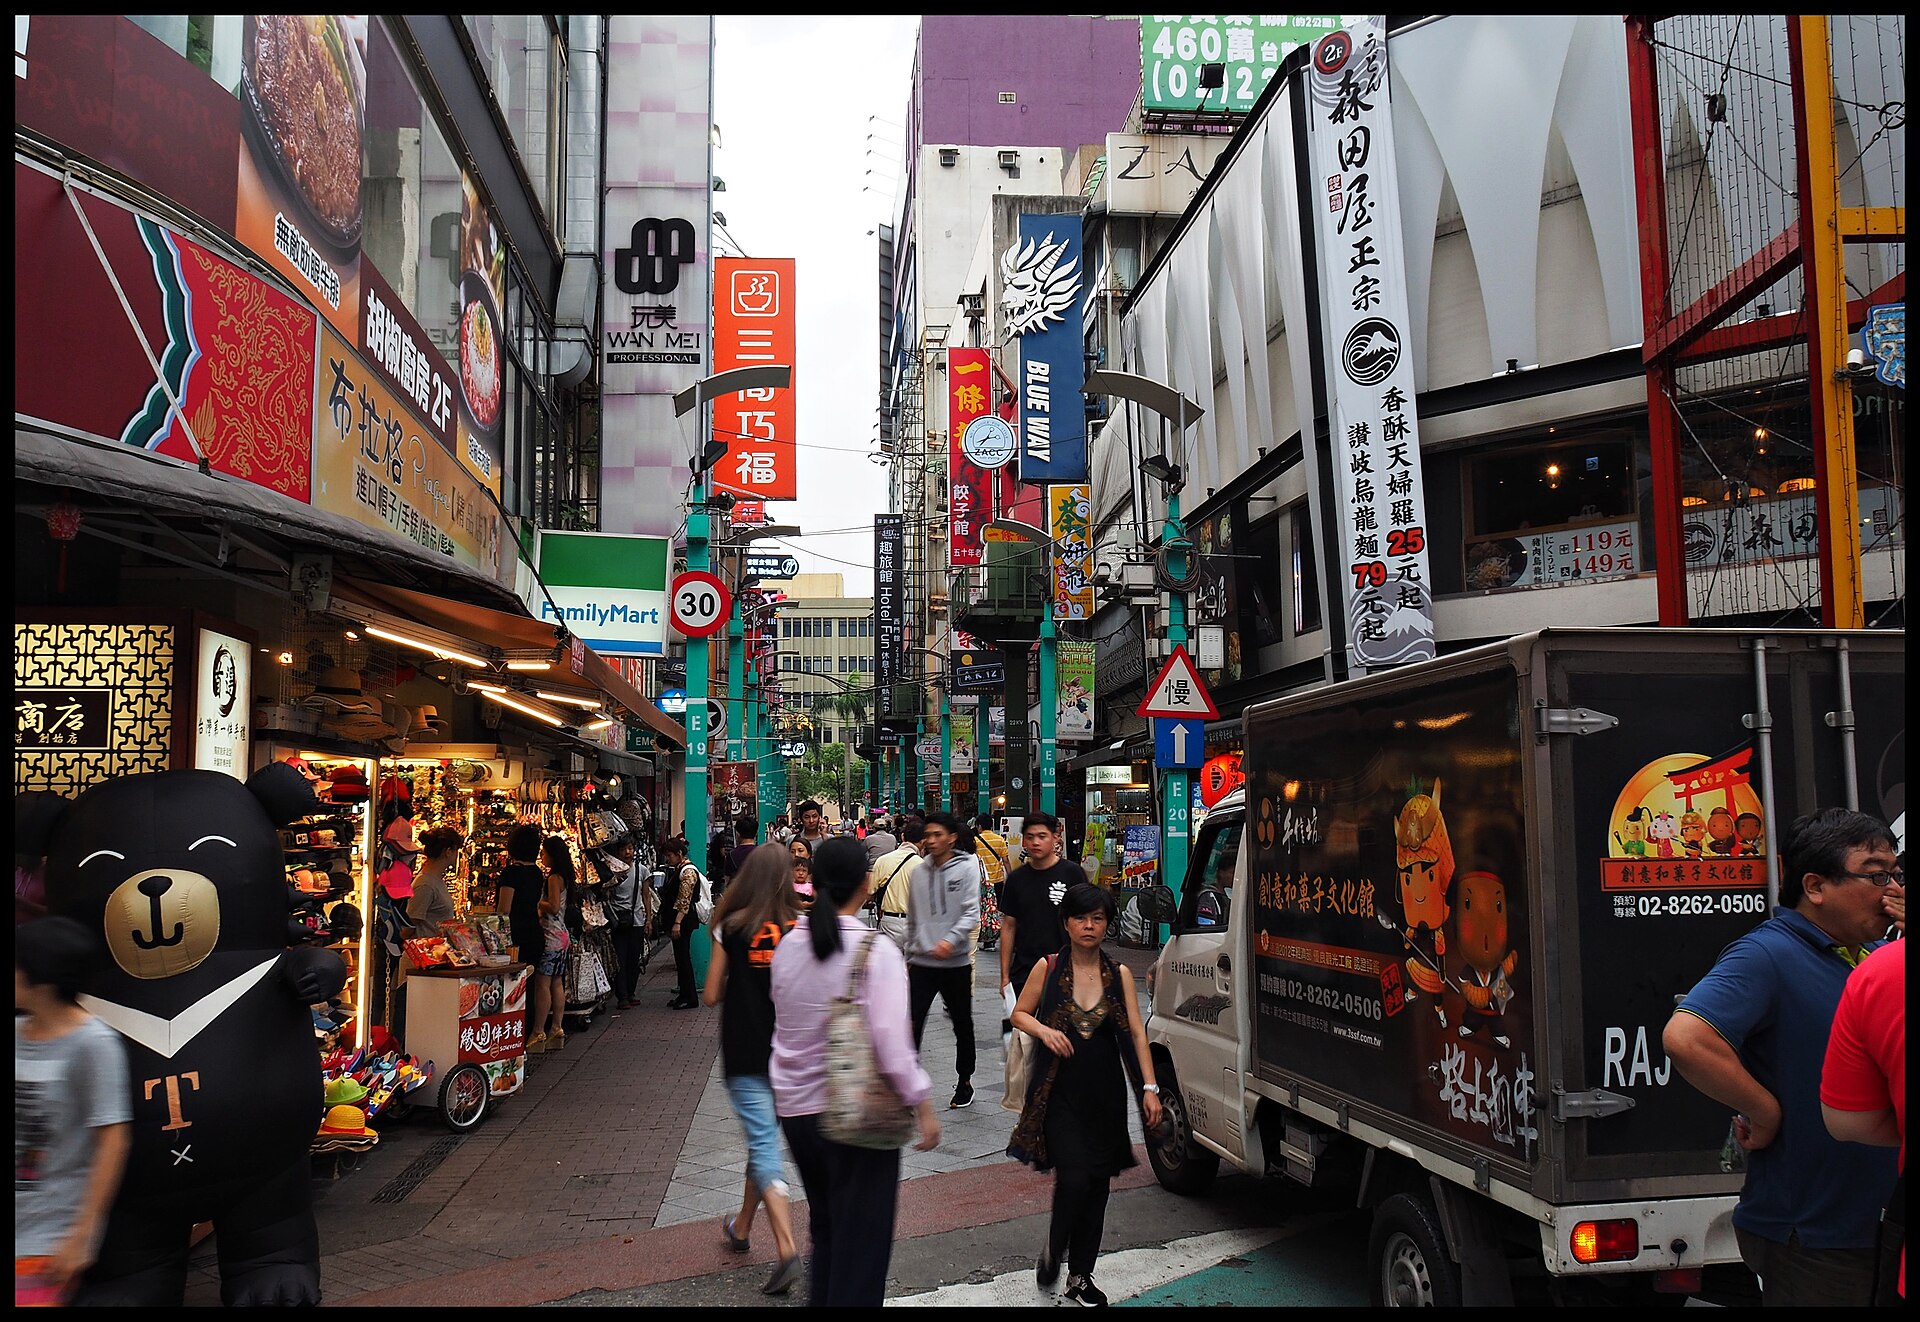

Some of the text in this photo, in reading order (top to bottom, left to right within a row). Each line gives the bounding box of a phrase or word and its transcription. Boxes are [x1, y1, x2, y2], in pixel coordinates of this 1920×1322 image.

[1153, 27, 1255, 62] 460萬
[1325, 44, 1343, 63] 2F
[1118, 144, 1224, 182] ZA
[1328, 69, 1381, 311] 森田屋正宗
[631, 304, 678, 329] 玩美
[607, 332, 700, 348] WAN MEI
[367, 288, 452, 433] 胡椒廚房 2F
[613, 354, 695, 363] PROFESSIONAL
[329, 357, 405, 485] 布拉格
[1027, 360, 1050, 463] BLUE WAY
[975, 448, 1003, 457] ZACC
[953, 484, 970, 536] 餃子館
[1380, 385, 1426, 613] 香酥天婦羅25元起
[953, 548, 985, 558] 五十年老
[1571, 529, 1634, 554] 119元
[879, 541, 893, 583] 趣旅館
[1573, 552, 1635, 575] 149元
[541, 600, 659, 626] FamilyMart
[680, 592, 715, 617] 30
[880, 587, 893, 621] Hotel
[880, 625, 893, 649] Fun
[1165, 679, 1191, 705] 慢
[15, 697, 85, 734] 商店
[691, 715, 701, 731] E
[687, 742, 707, 756] 19
[1045, 750, 1052, 760] E
[1042, 768, 1056, 776] 18
[1173, 782, 1182, 797] E
[1168, 808, 1187, 821] 20
[1621, 864, 1754, 883] 創意和菓子文化館
[1258, 872, 1376, 918] 創意和菓子文化館
[1613, 894, 1765, 916] 預約 02-8262-0506
[1288, 979, 1382, 1022] 02-8262-0506
[1333, 1025, 1382, 1048] www.3ssf.com.tw
